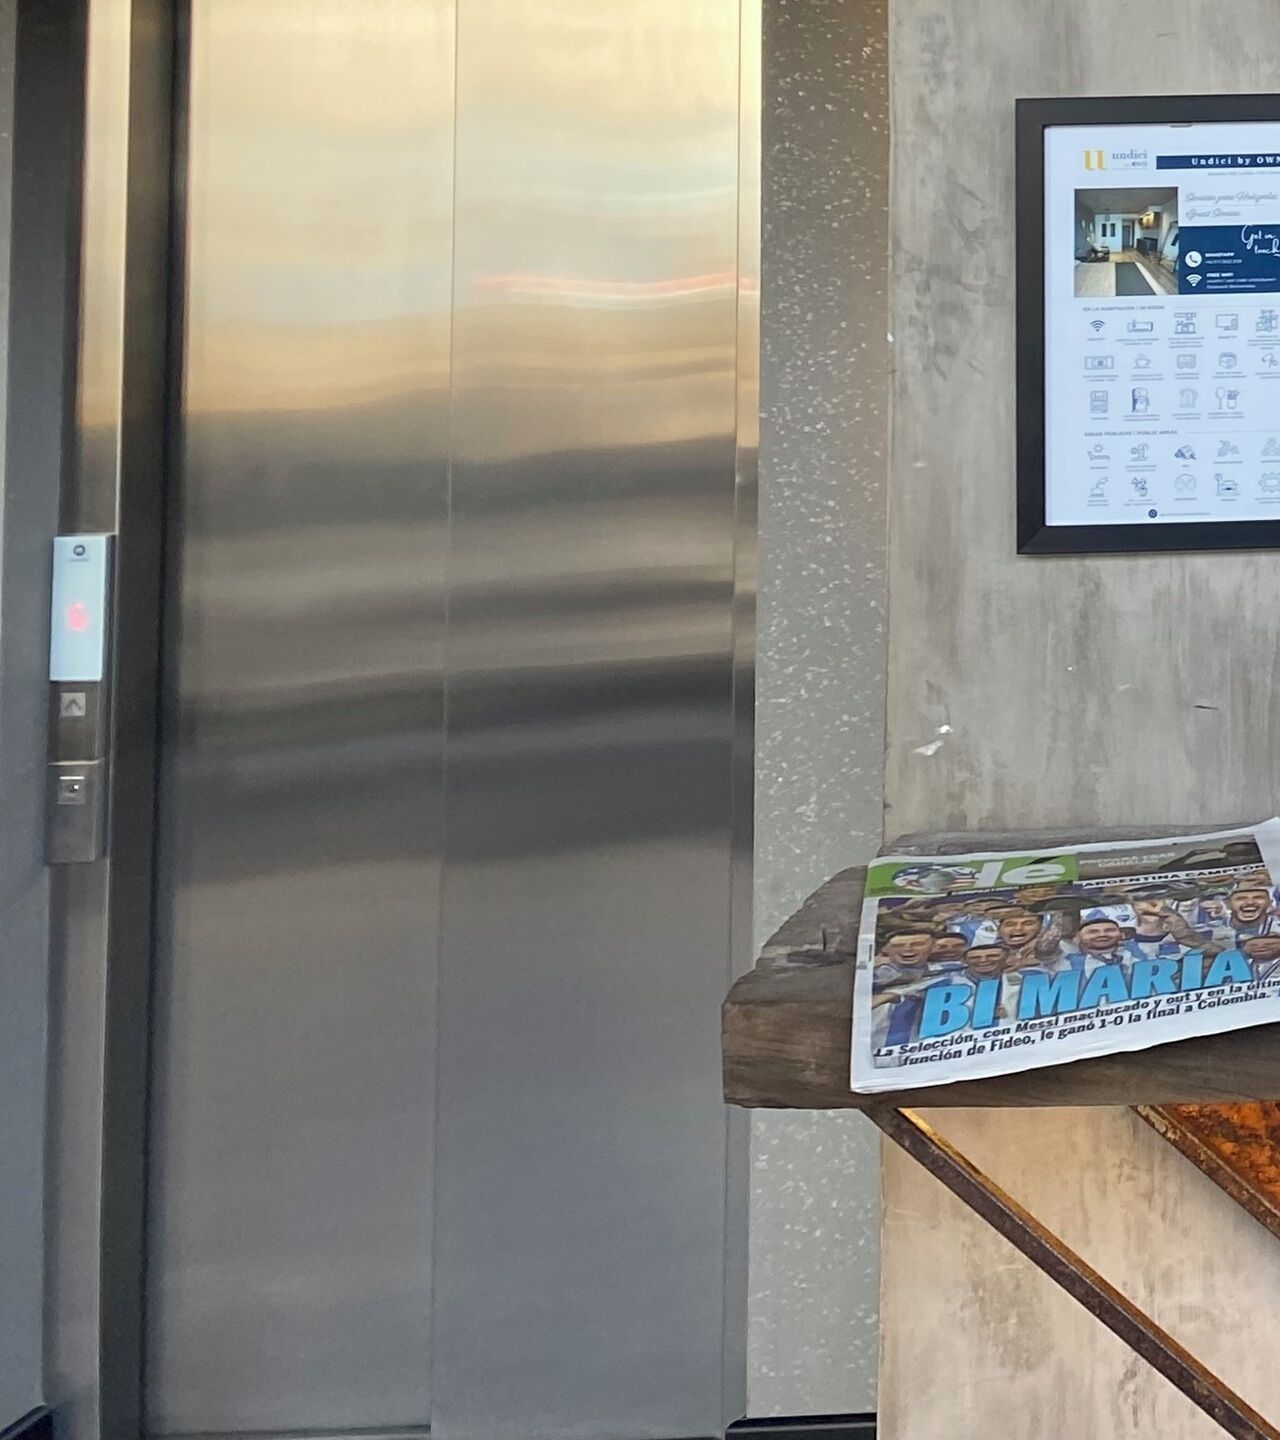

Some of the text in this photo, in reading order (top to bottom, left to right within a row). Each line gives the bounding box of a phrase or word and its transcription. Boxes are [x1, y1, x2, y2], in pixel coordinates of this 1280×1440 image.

[1112, 149, 1148, 160] undici
[1191, 157, 1232, 166] Undici
[1237, 156, 1252, 167] by
[1241, 224, 1262, 250] Get
[1083, 873, 1180, 888] ARGENTINA
[919, 946, 1253, 1040] BI MARÍA
[899, 1034, 978, 1055] Selección,
[983, 1026, 1011, 1039] con
[1015, 1018, 1060, 1033] Messi
[1063, 1000, 1150, 1025] machucado
[1153, 998, 1163, 1009] y
[1166, 992, 1191, 1005] out
[1194, 991, 1204, 1002] y
[1208, 987, 1226, 997] en
[1229, 983, 1243, 993] la
[902, 990, 1272, 1067] función de Fideo, le ganó 1-0 la final a Colombia.
